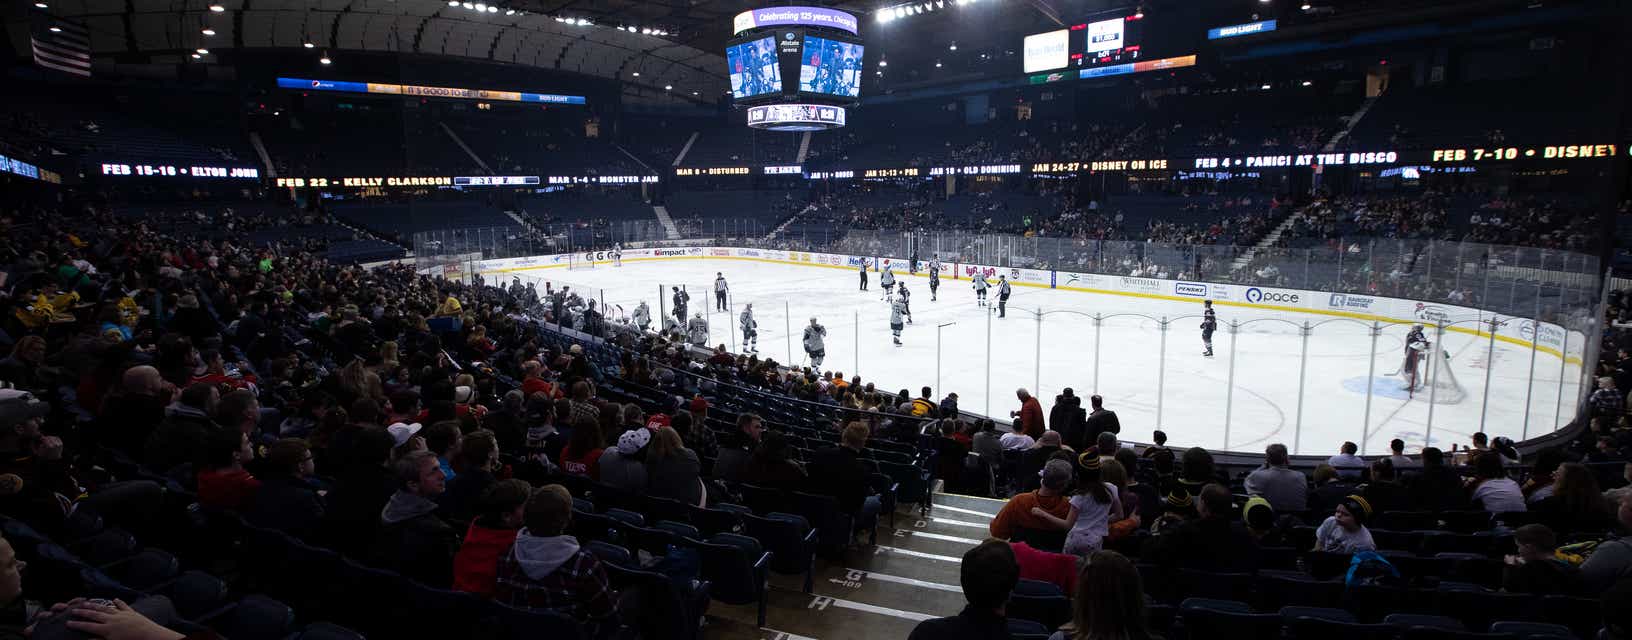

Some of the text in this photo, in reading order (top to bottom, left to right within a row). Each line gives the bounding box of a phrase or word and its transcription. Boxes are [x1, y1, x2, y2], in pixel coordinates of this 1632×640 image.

[759, 11, 799, 22] Celebrating
[800, 12, 812, 21] 125
[1238, 23, 1262, 33] LIGHT
[423, 87, 449, 97] GOOD
[1433, 145, 1616, 161] FEB 7-10 DISNEY
[1196, 158, 1218, 168] FEB
[1222, 158, 1230, 167] 4
[1294, 154, 1314, 166] AT
[1315, 154, 1344, 166] THE
[1349, 152, 1397, 164] DISCO
[102, 164, 258, 178] FEB 15-16 ELTON JOHN
[676, 168, 693, 176] MAR
[708, 167, 750, 175] DISTURBED
[929, 168, 943, 176] JAN
[963, 166, 979, 175] OLD
[980, 164, 1021, 174] DOMINION
[1032, 160, 1167, 172] JAN 24-27 DISNEY ON ICE
[276, 177, 451, 187] FEB 22 KELLY CLARKSON
[549, 176, 570, 184] MAR
[641, 175, 659, 183] JAM
[660, 248, 687, 257] impact
[1263, 292, 1299, 303] pace
[846, 568, 862, 581] G
[807, 596, 833, 611] H
